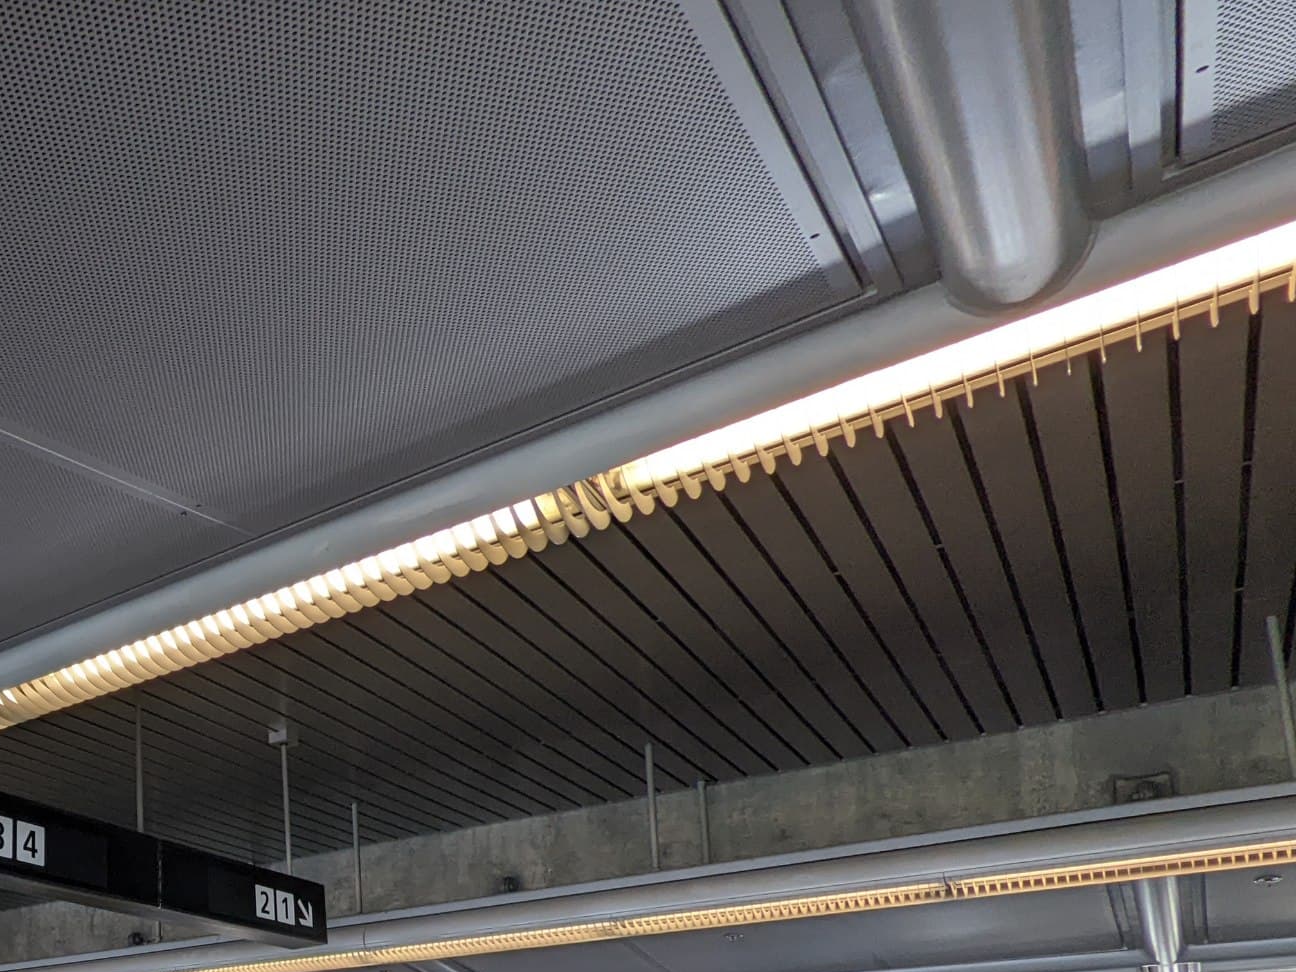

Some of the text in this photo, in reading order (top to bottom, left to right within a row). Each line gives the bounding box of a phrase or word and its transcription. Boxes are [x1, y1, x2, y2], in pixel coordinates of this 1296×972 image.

[22, 829, 38, 859] 4
[260, 890, 289, 920] 2 1
